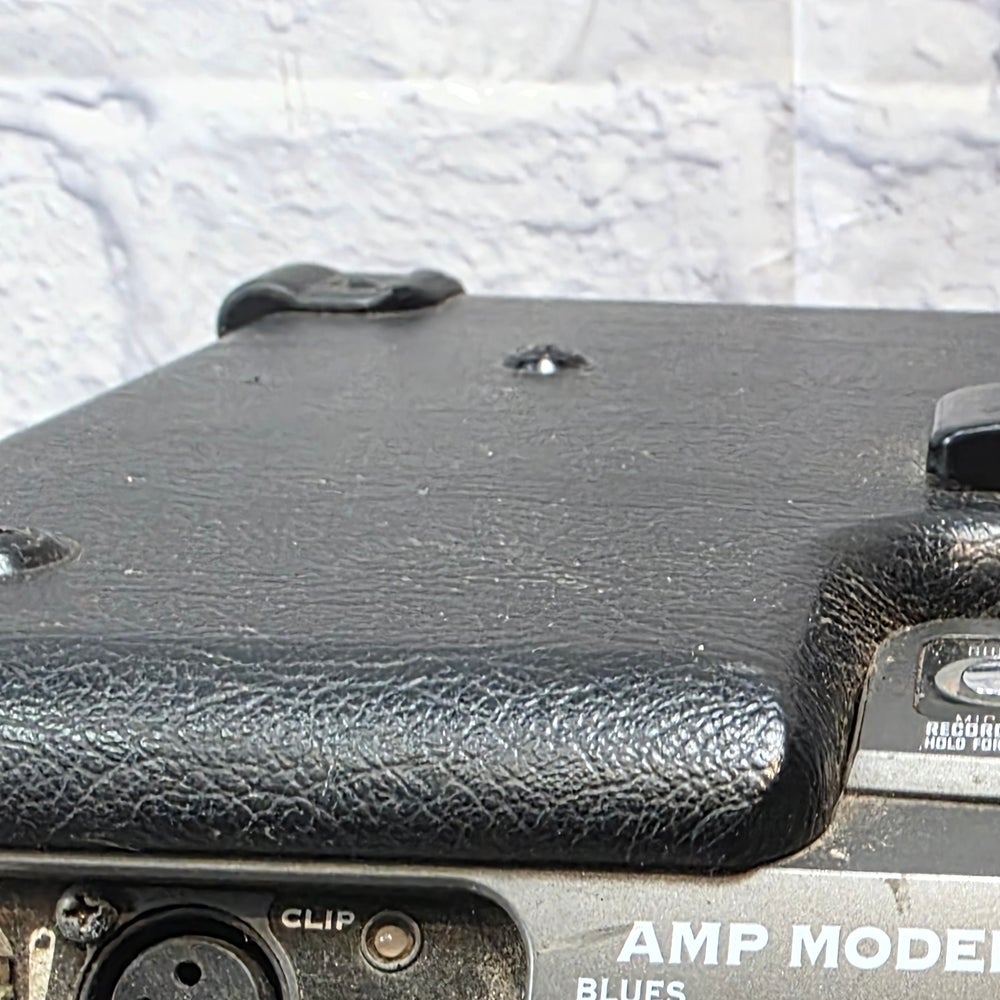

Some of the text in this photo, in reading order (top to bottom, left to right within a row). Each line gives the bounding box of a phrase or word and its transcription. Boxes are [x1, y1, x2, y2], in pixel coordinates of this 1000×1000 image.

[924, 736, 966, 751] HOLD
[281, 908, 357, 931] CLIP
[616, 921, 769, 966] AMP
